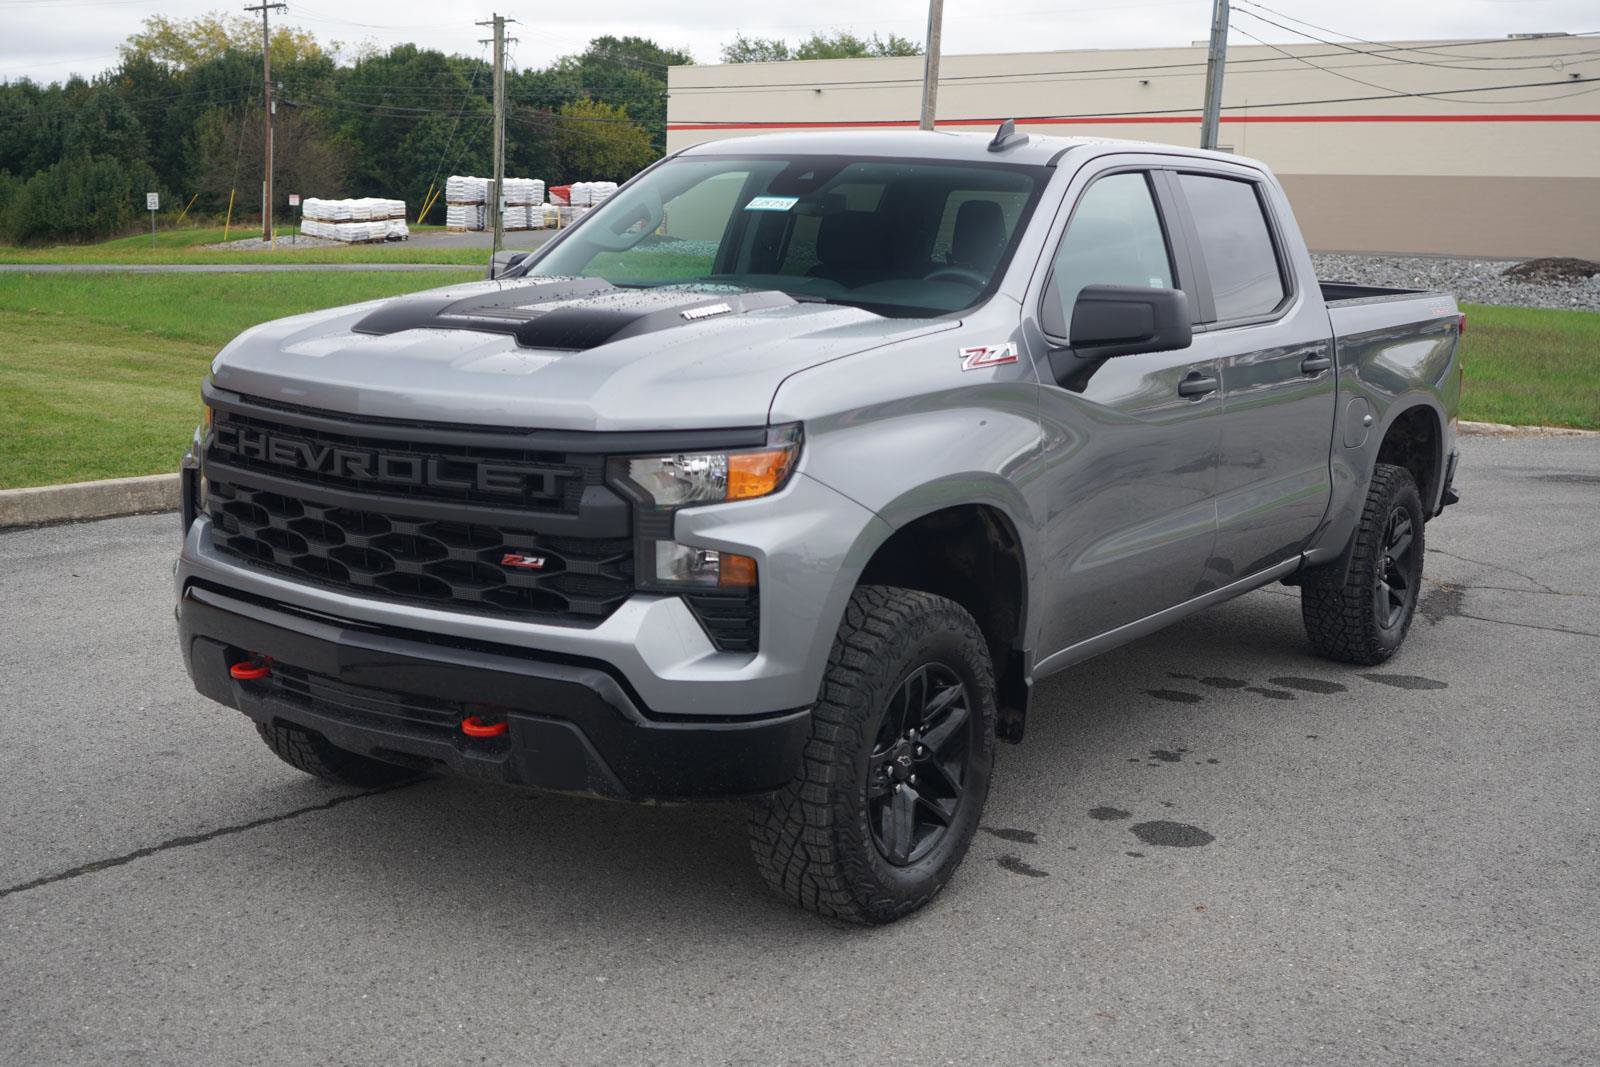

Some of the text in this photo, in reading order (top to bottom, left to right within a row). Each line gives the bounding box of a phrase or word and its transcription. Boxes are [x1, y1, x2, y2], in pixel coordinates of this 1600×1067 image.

[959, 342, 1018, 372] Z71
[212, 425, 576, 497] CHEVROLET
[501, 554, 545, 568] Z71
